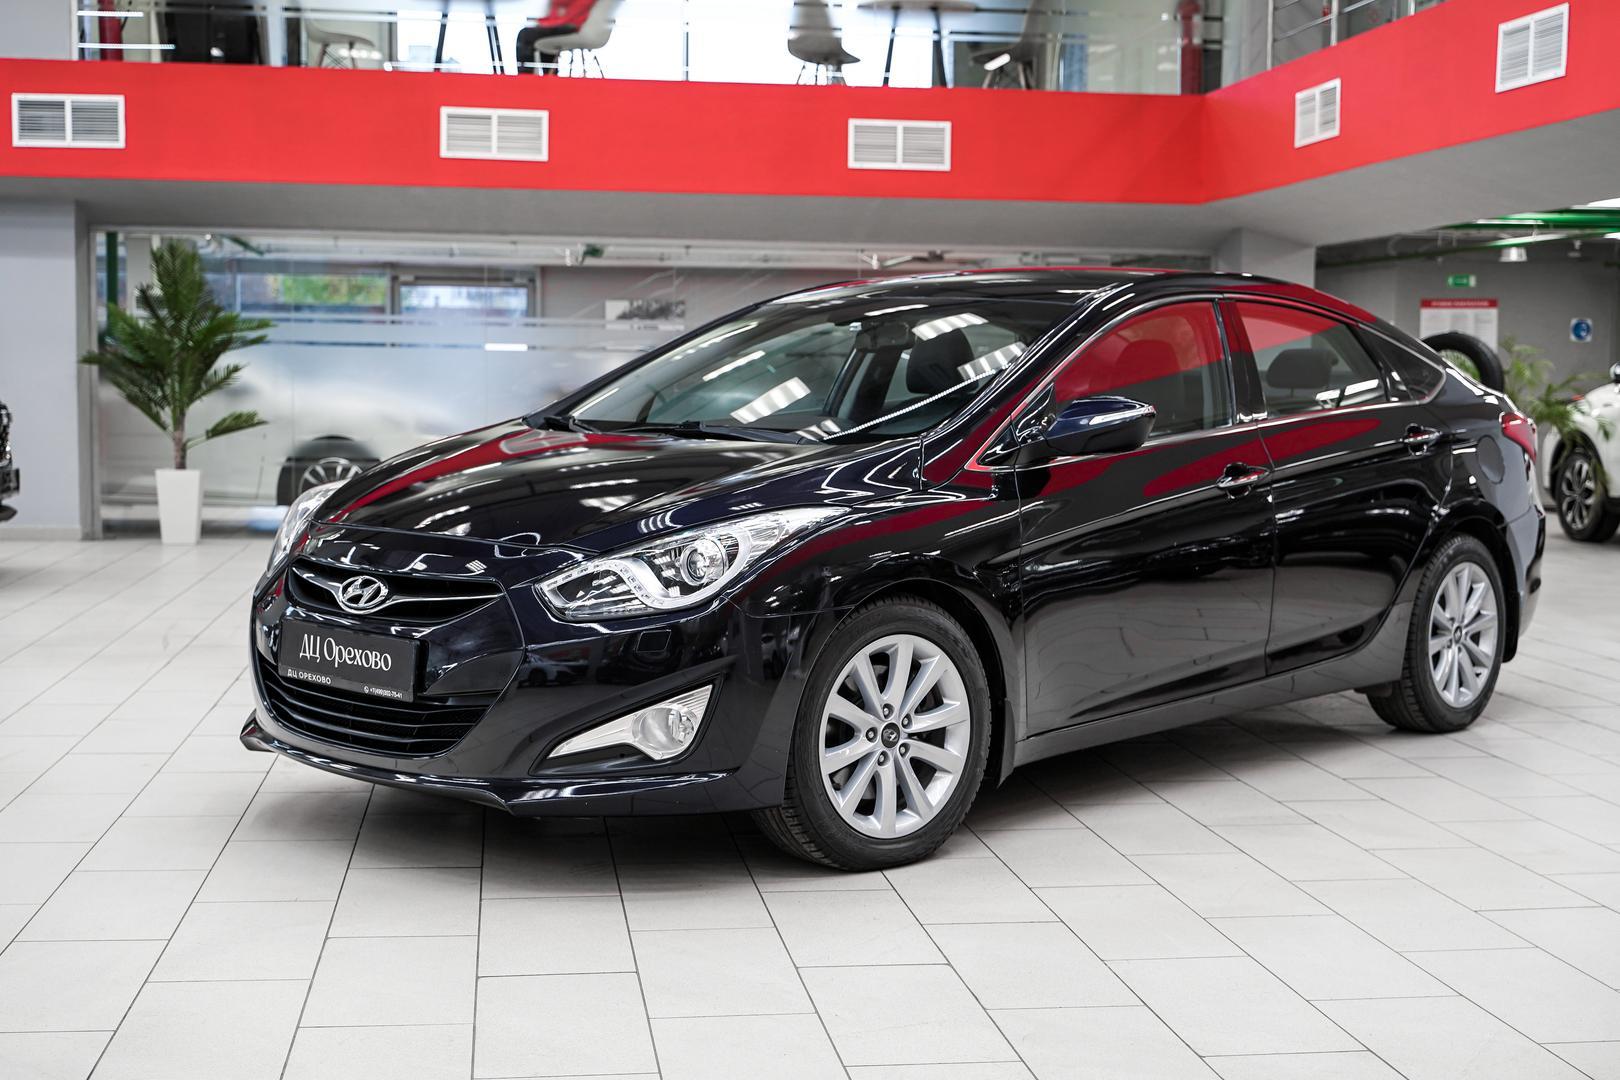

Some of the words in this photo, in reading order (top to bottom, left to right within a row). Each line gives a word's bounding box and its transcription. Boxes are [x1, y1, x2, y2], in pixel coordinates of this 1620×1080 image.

[299, 633, 321, 663] ДЦ
[323, 637, 392, 672] Орехово
[287, 668, 298, 679] ДЦ
[298, 672, 332, 685] ОРЕХОВО
